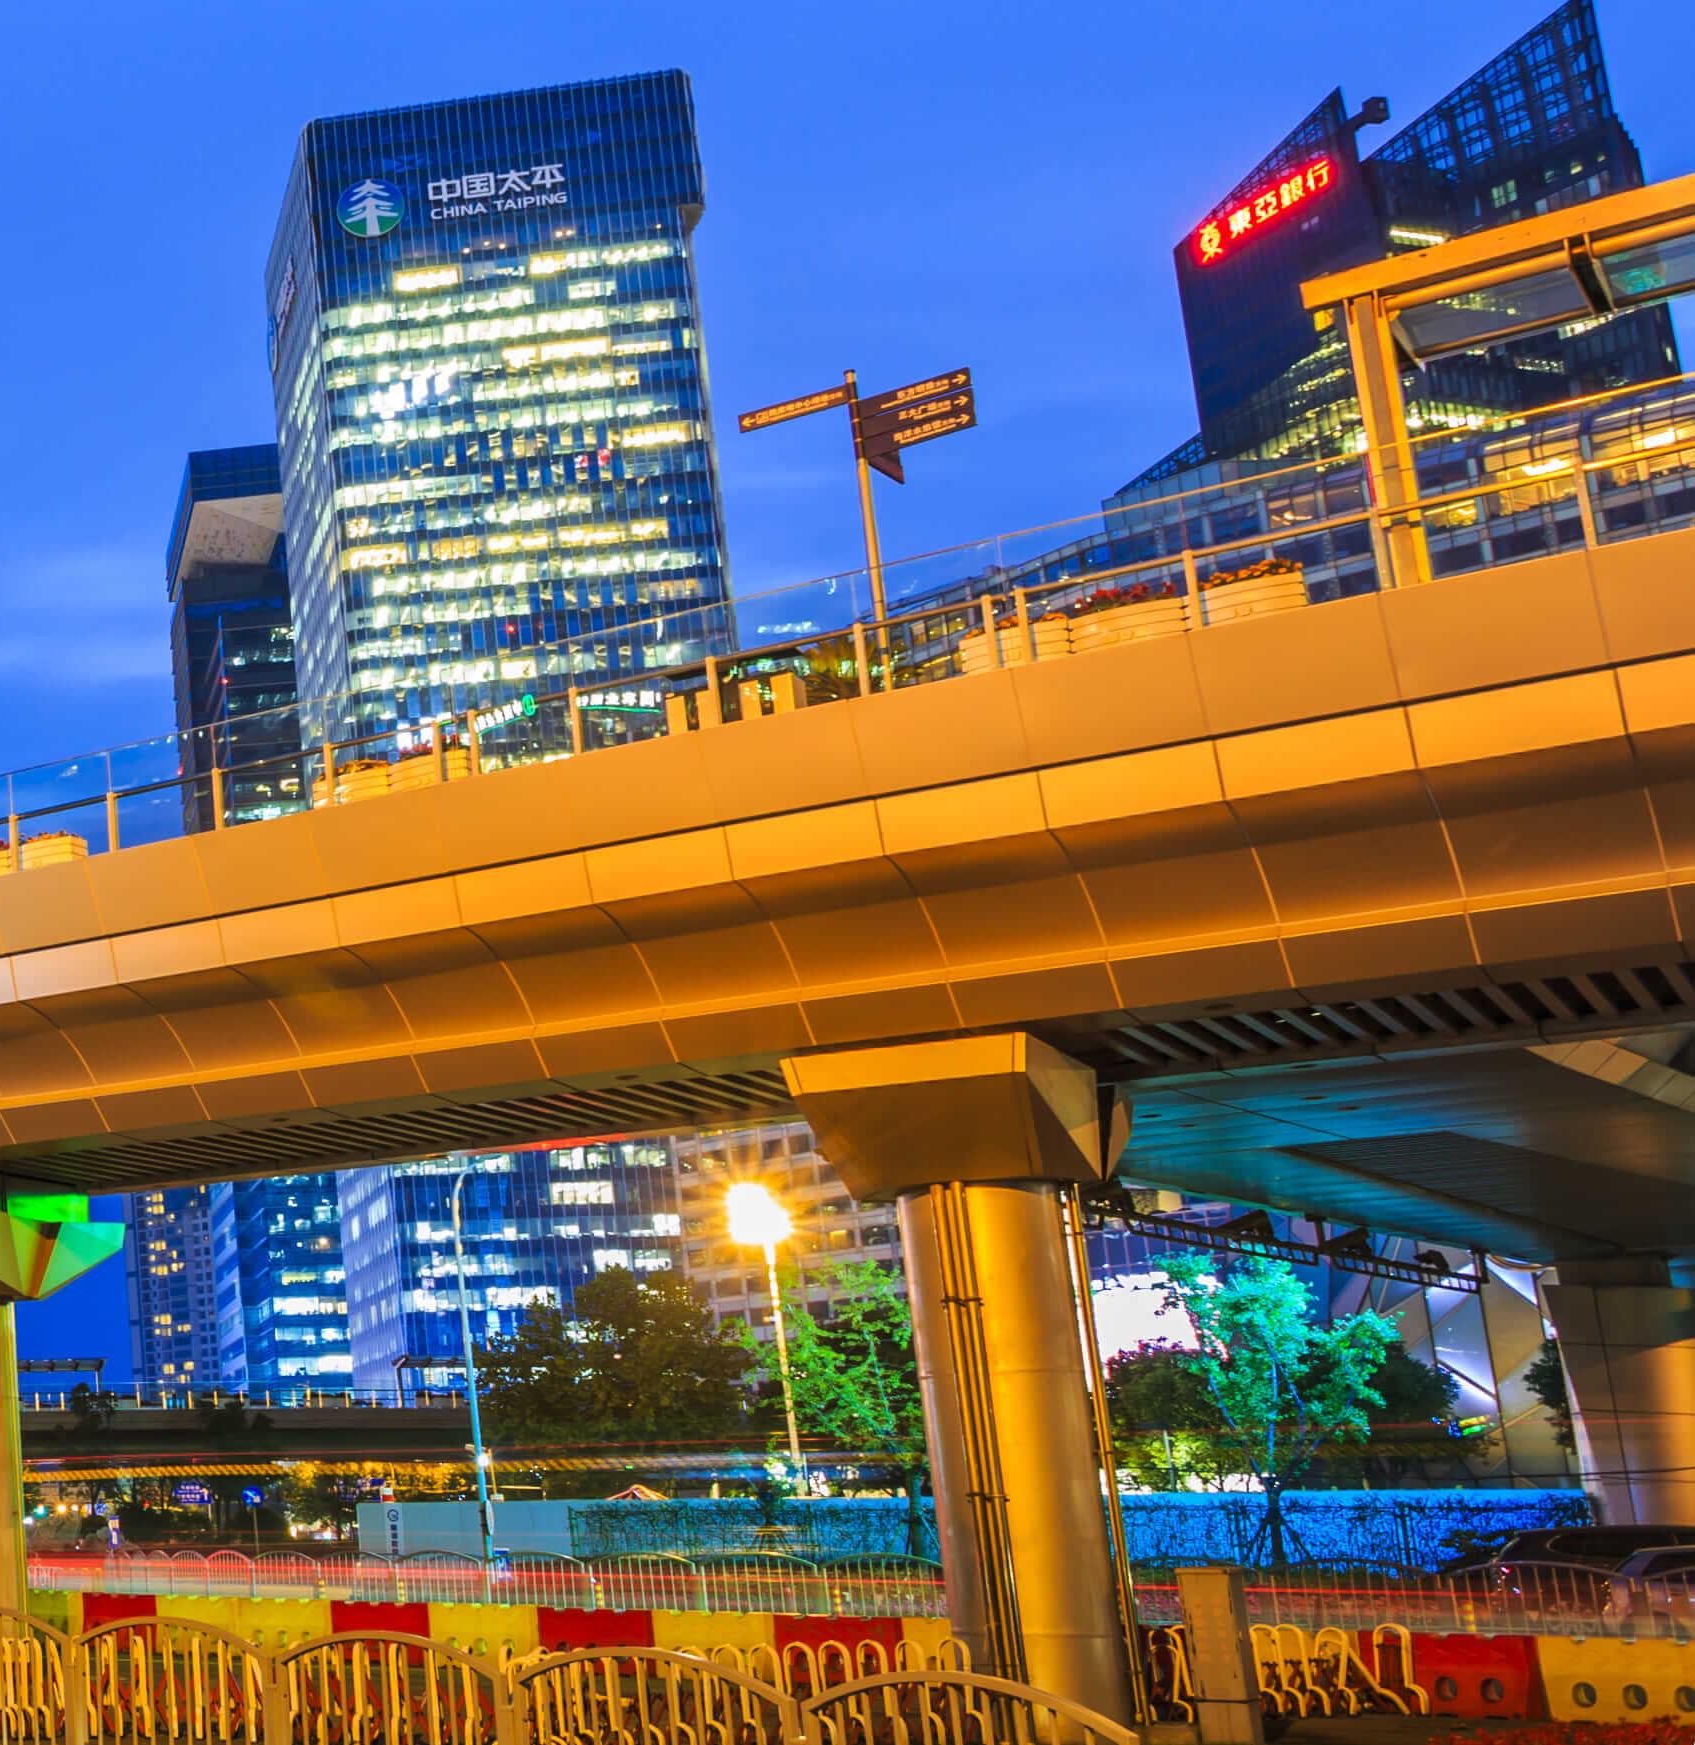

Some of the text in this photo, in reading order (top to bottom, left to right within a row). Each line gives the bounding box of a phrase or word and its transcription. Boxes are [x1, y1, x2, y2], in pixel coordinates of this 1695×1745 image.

[427, 163, 566, 203] 中国太平
[1228, 159, 1330, 239] 東亞銀行
[430, 191, 568, 220] CHINA TAIPING
